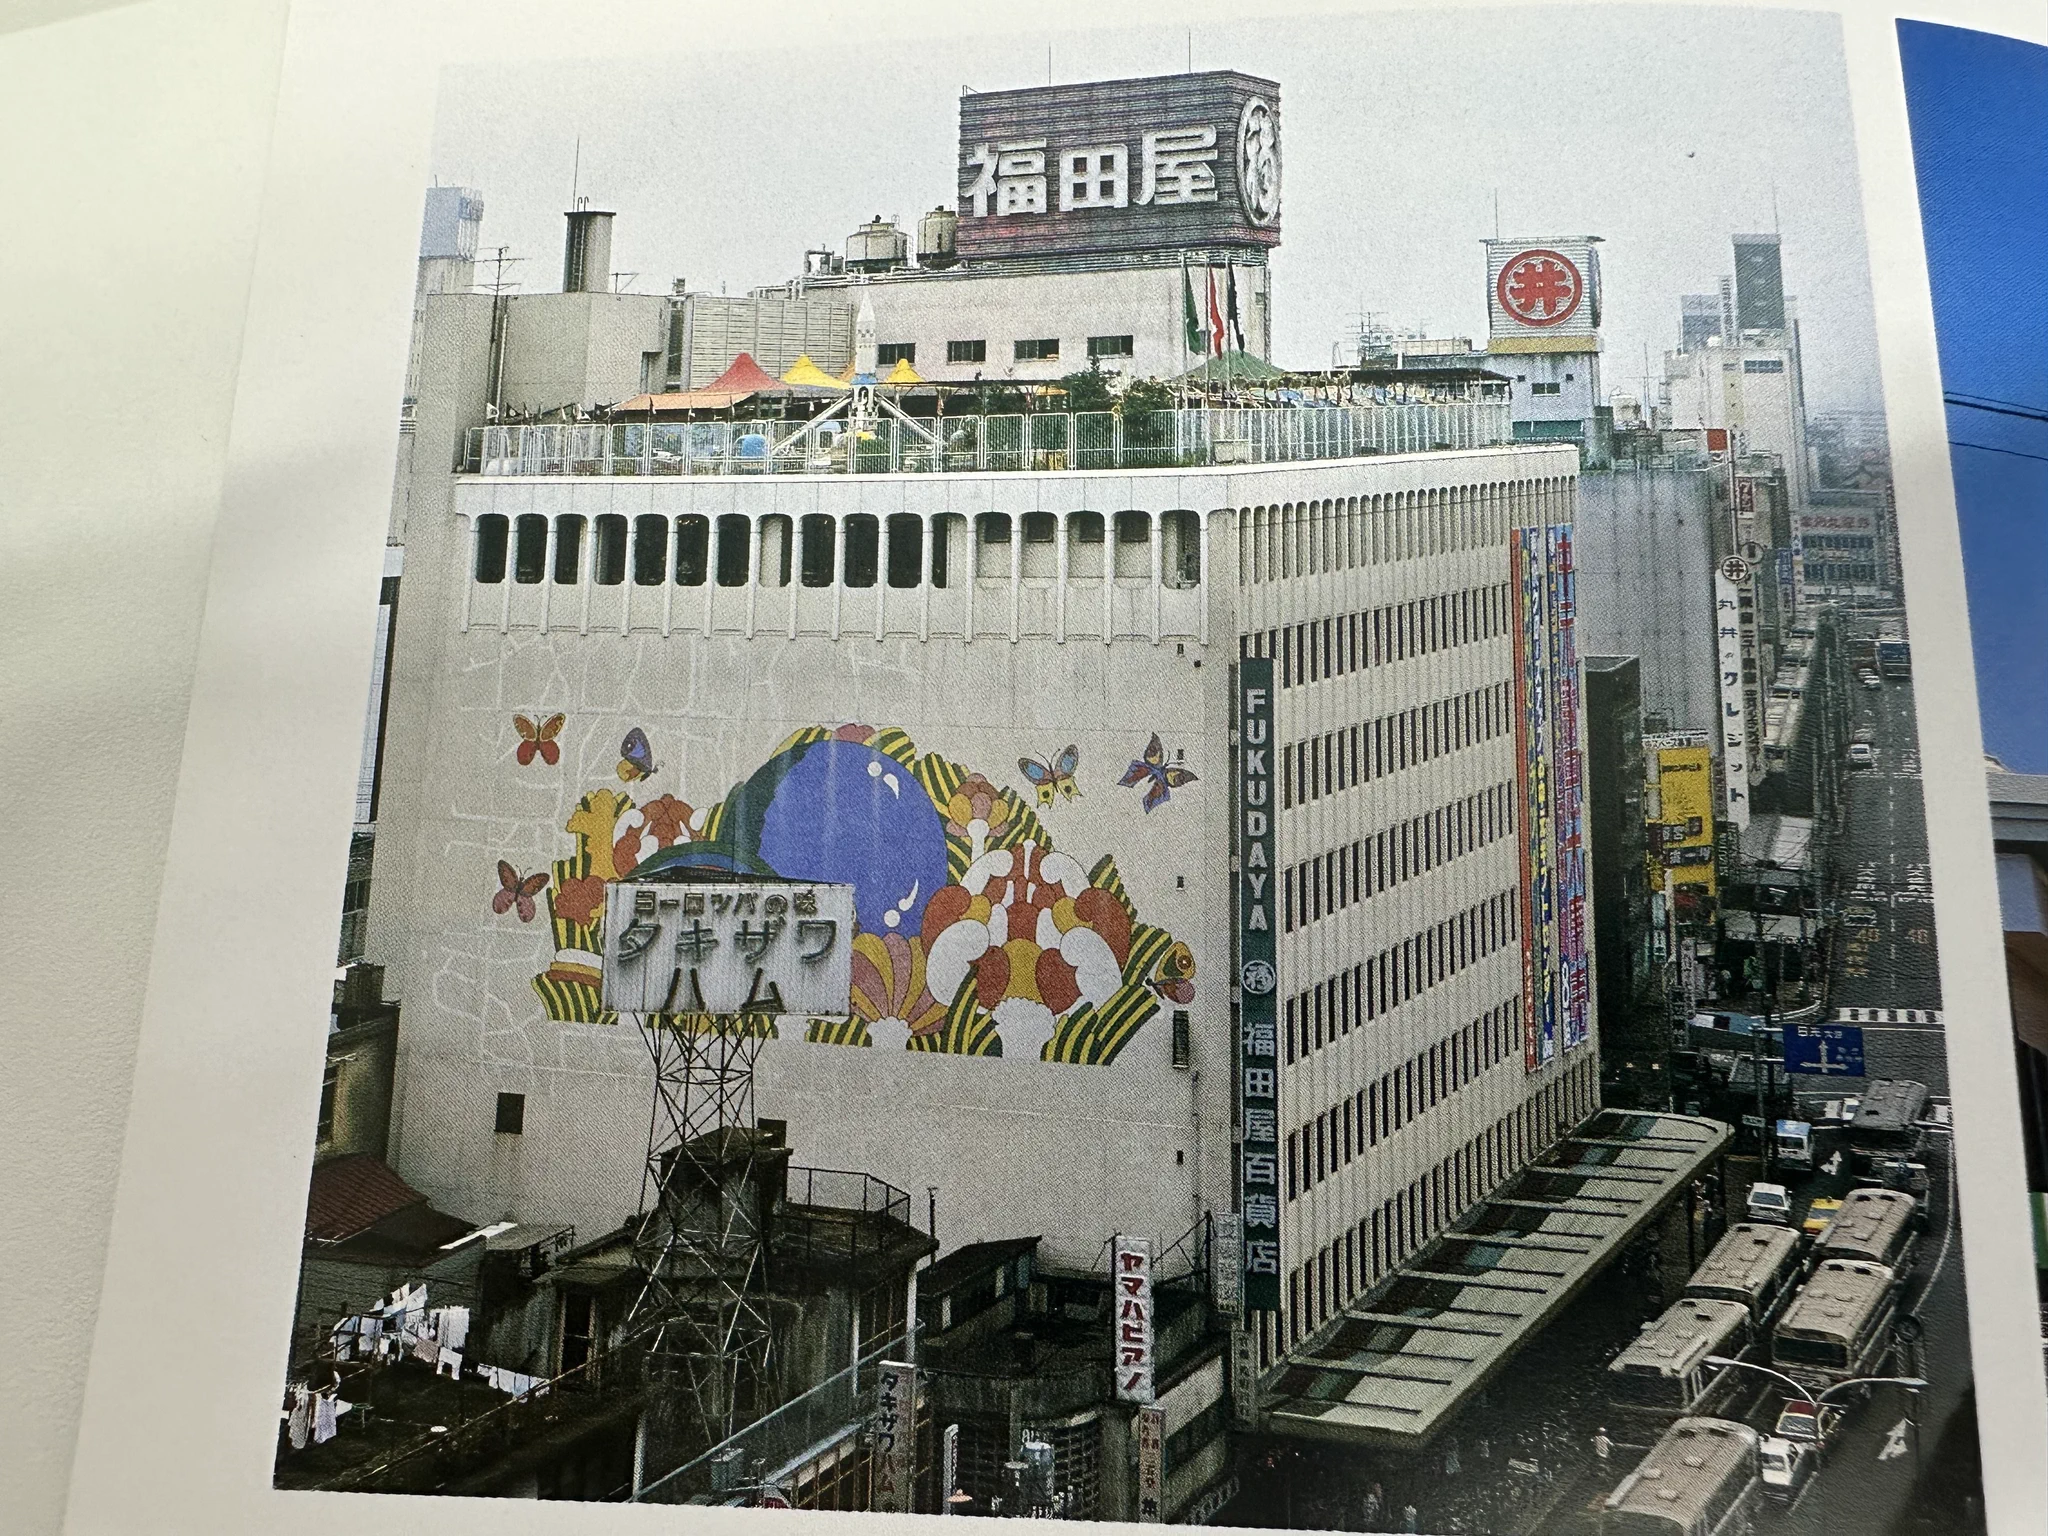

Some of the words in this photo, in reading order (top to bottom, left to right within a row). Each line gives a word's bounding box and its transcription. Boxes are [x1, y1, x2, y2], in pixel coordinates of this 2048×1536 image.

[960, 124, 1218, 217] 福田屋
[1718, 598, 1746, 803] 丸井のクレジット
[1246, 688, 1268, 930] FUKUDAYA
[617, 917, 837, 964] タキザワ
[661, 967, 787, 1012] ハム
[1243, 1022, 1277, 1276] 福田屋百貨店
[1120, 1252, 1145, 1391] ヤマハピアノ
